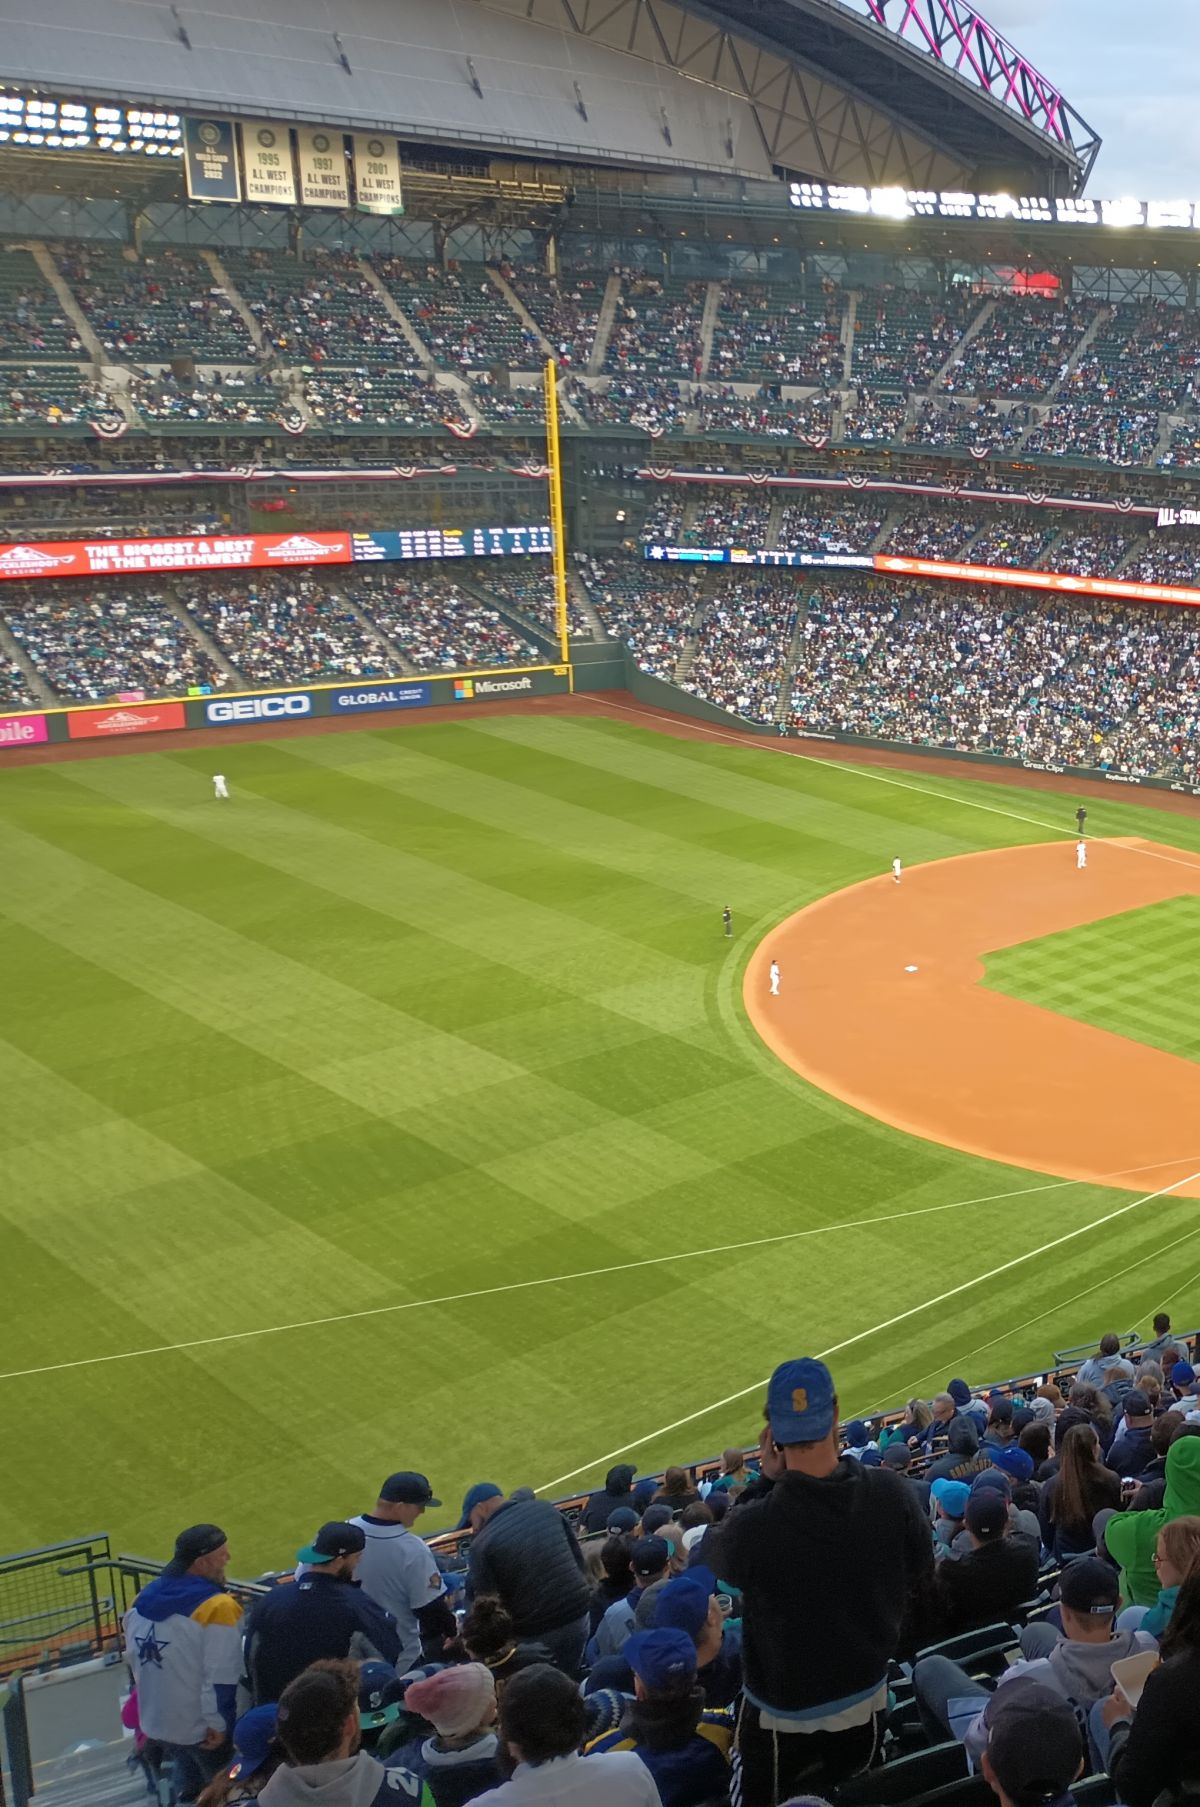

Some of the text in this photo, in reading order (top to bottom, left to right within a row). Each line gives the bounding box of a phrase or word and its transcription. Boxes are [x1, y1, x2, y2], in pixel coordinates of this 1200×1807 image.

[257, 153, 280, 166] 1995
[312, 157, 333, 170] 1997
[252, 168, 287, 181] A.L. WEST
[367, 162, 388, 175] 2001
[307, 173, 340, 186] A.L. WEST
[362, 177, 394, 190] A.L. WEST
[249, 183, 293, 196] CHAMPIONS
[304, 187, 347, 201] CHAMPIONS
[360, 191, 400, 204] CHAMPIONS
[85, 540, 255, 558] THE BIGGEST & BEST
[90, 552, 253, 570] IN THE NORTHWEST
[475, 677, 532, 693] Microsoft
[338, 691, 398, 706] GLOBAL
[207, 694, 310, 722] GEICO
[1023, 760, 1064, 773] Great Clips
[791, 1388, 808, 1412] S
